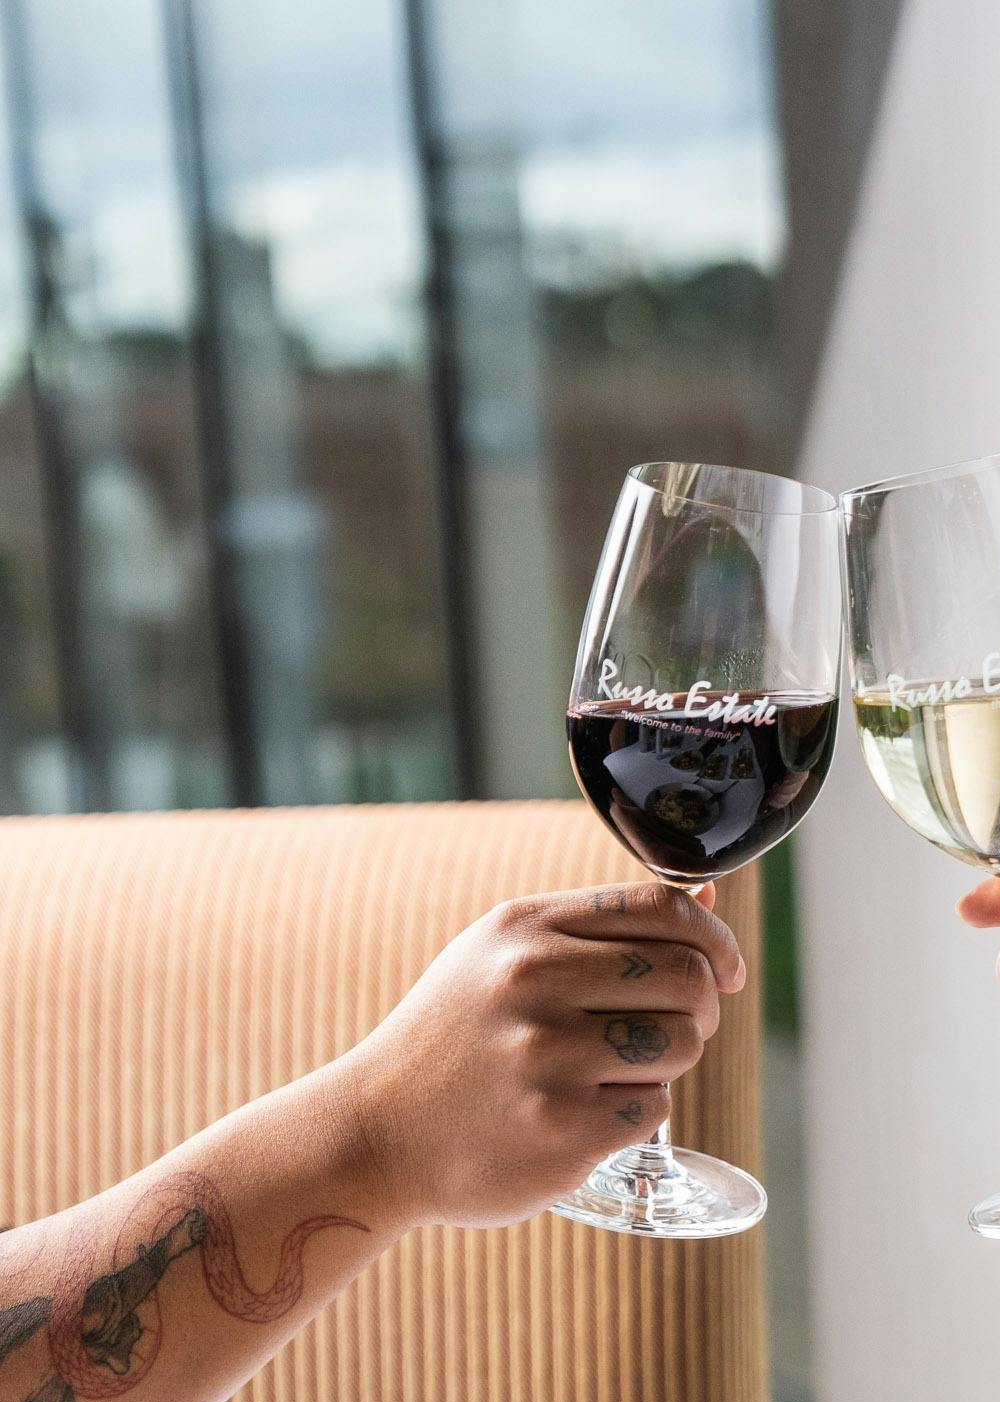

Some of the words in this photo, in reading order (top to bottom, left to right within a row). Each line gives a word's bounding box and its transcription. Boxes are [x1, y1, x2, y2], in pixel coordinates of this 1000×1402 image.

[598, 658, 674, 711] Russo
[684, 681, 777, 725] Estate
[887, 673, 972, 712] Russo
[671, 722, 682, 732] to
[685, 725, 702, 736] the
